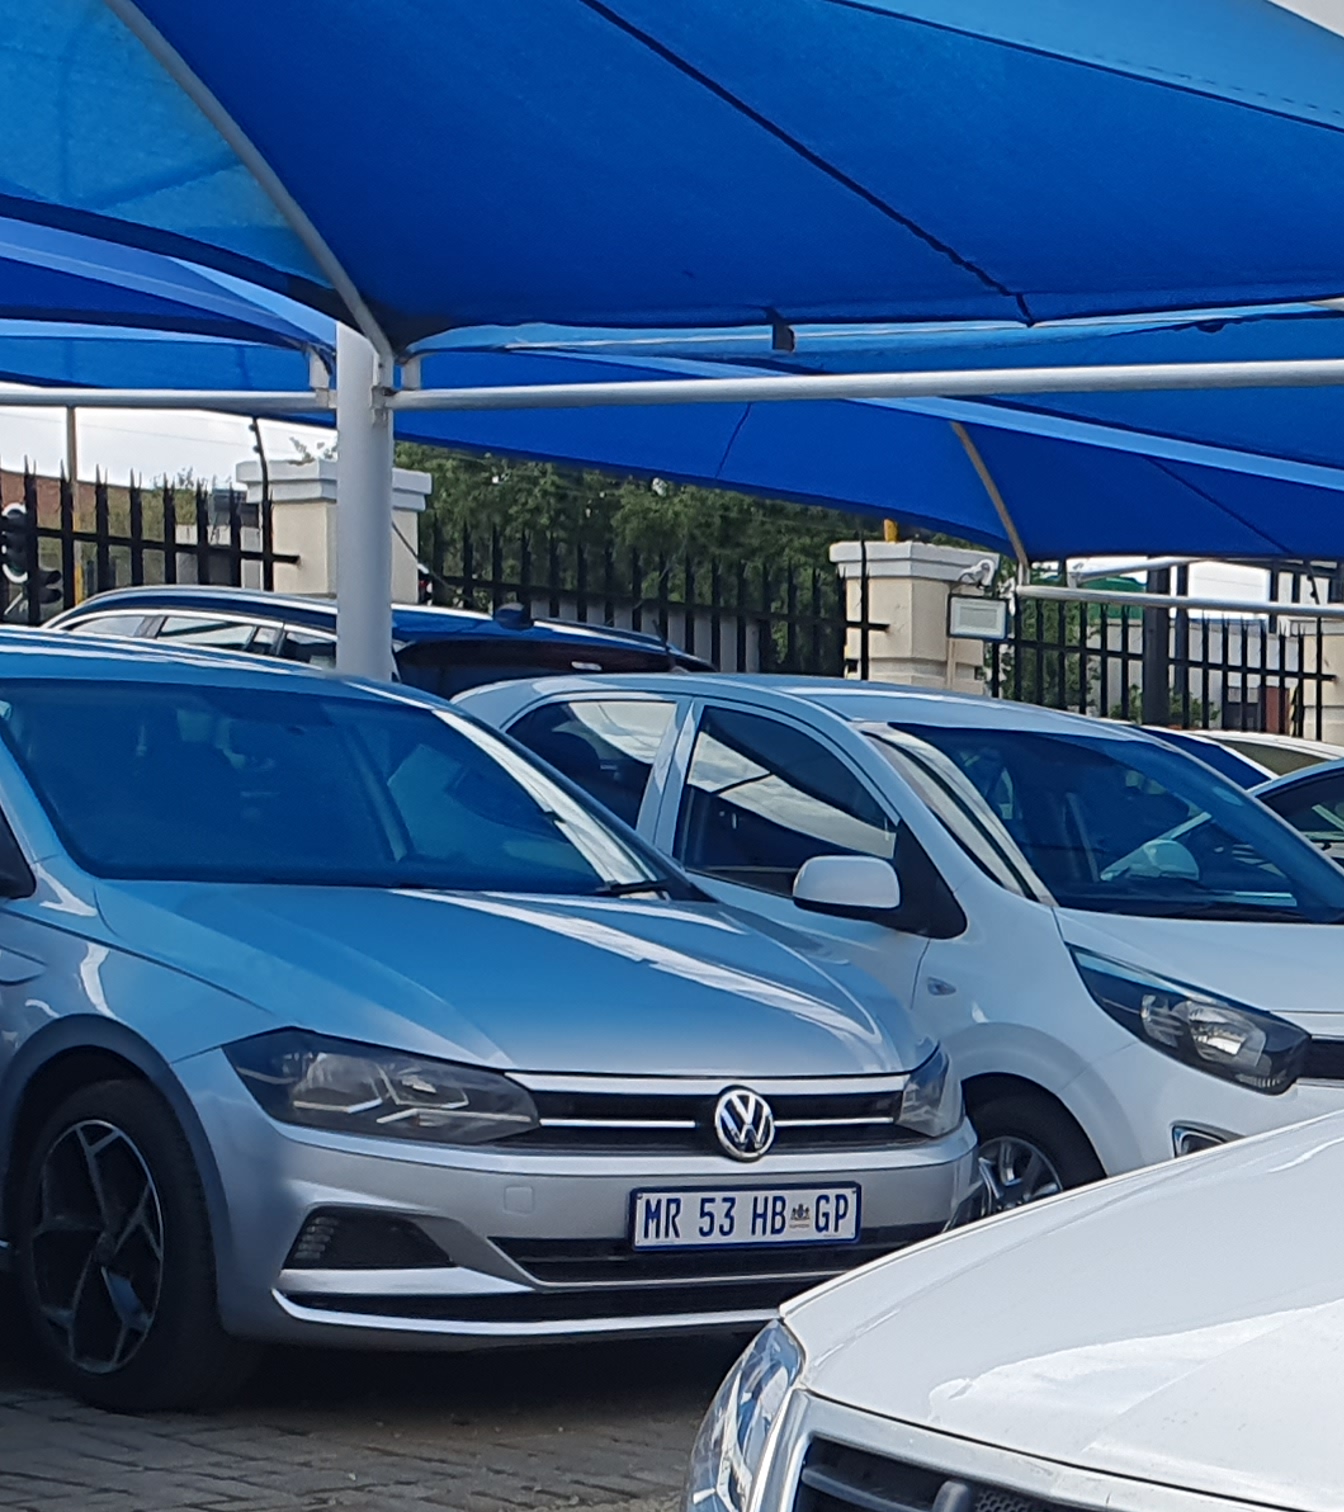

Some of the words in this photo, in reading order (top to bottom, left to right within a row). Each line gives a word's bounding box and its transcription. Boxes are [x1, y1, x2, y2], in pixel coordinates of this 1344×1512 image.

[644, 1197, 681, 1239] MR
[698, 1196, 736, 1237] 53
[751, 1195, 787, 1236] HB
[815, 1194, 849, 1233] GP
